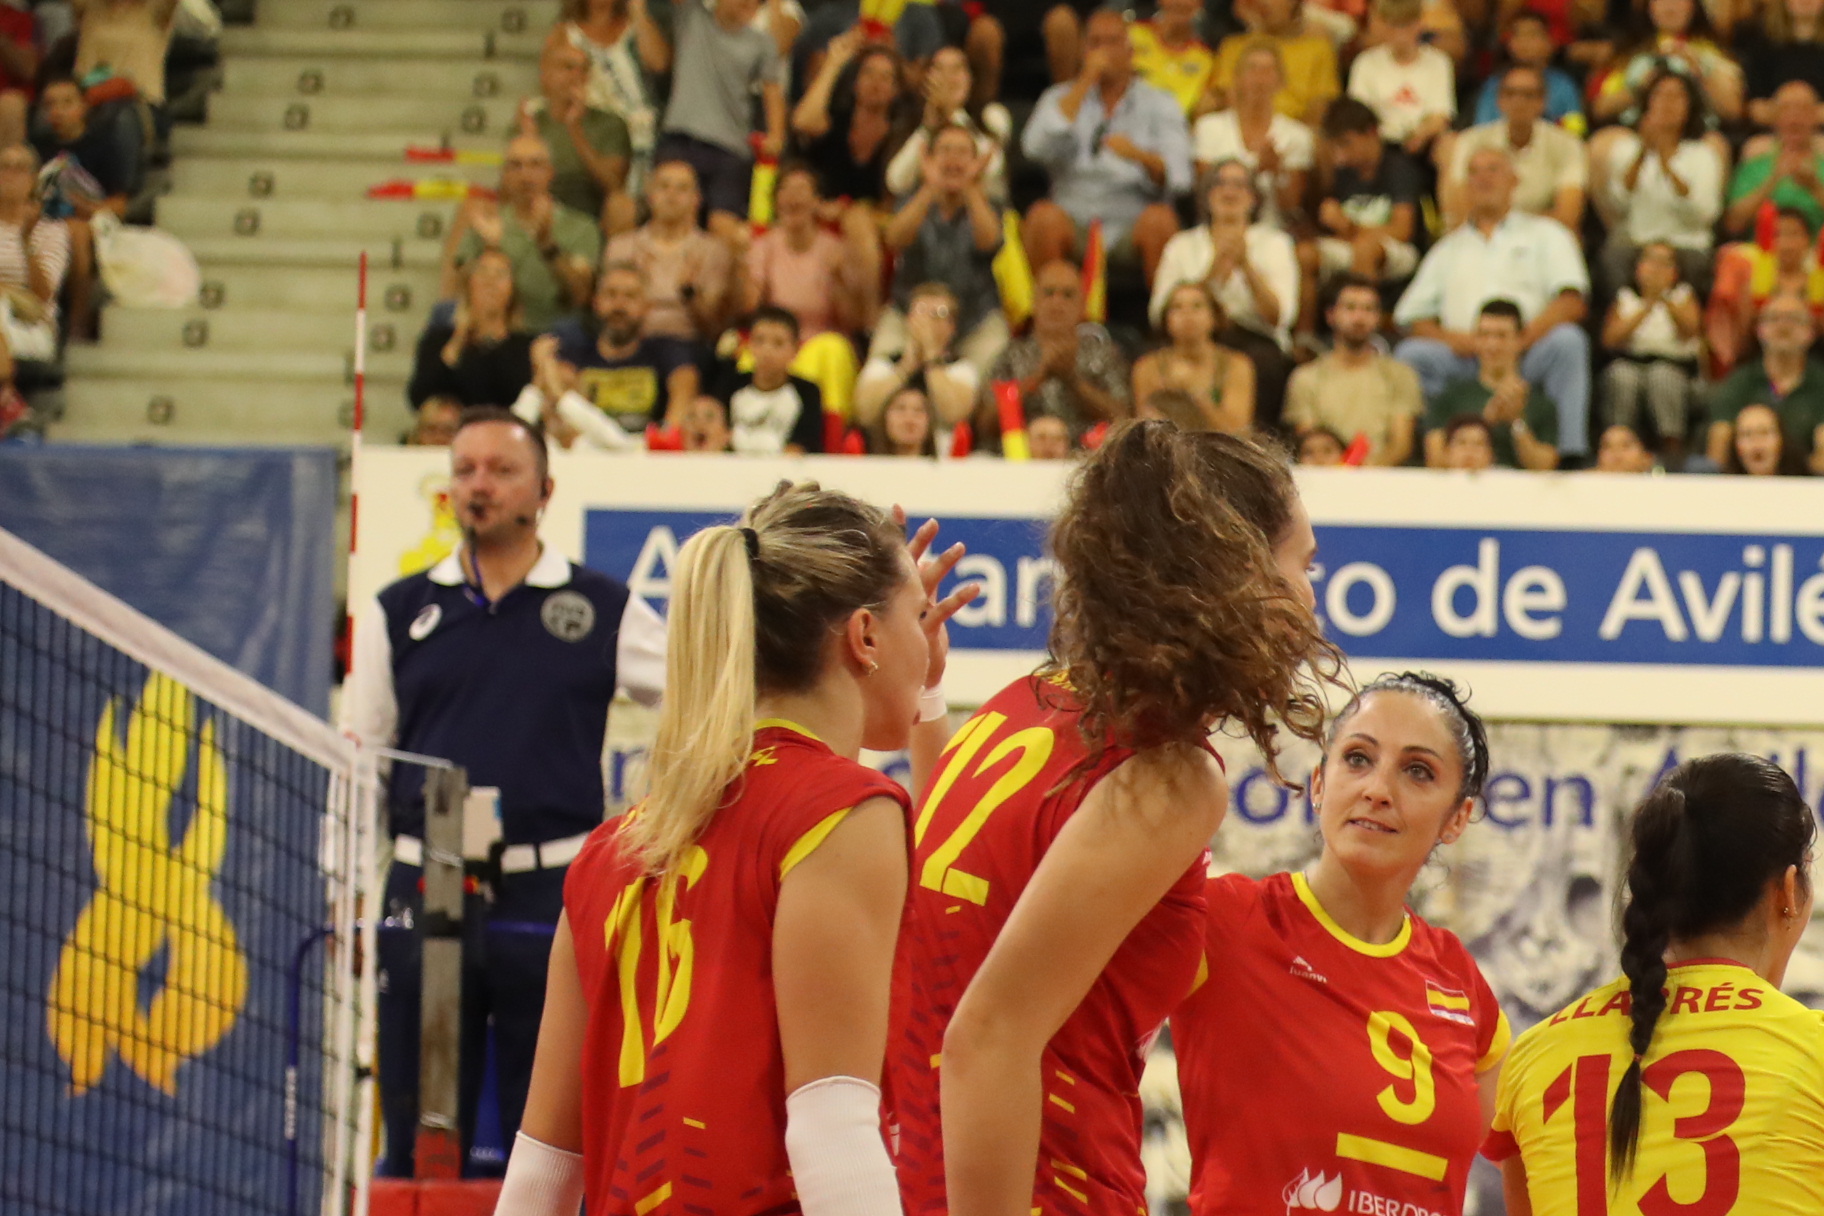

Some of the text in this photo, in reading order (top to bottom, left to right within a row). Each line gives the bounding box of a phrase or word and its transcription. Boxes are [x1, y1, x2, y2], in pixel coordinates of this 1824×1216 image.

[1430, 537, 1568, 640] de
[914, 711, 1055, 907] 12
[604, 844, 708, 1089] 16
[1549, 981, 1764, 1027] LLARÉS
[1367, 1010, 1435, 1125] 9
